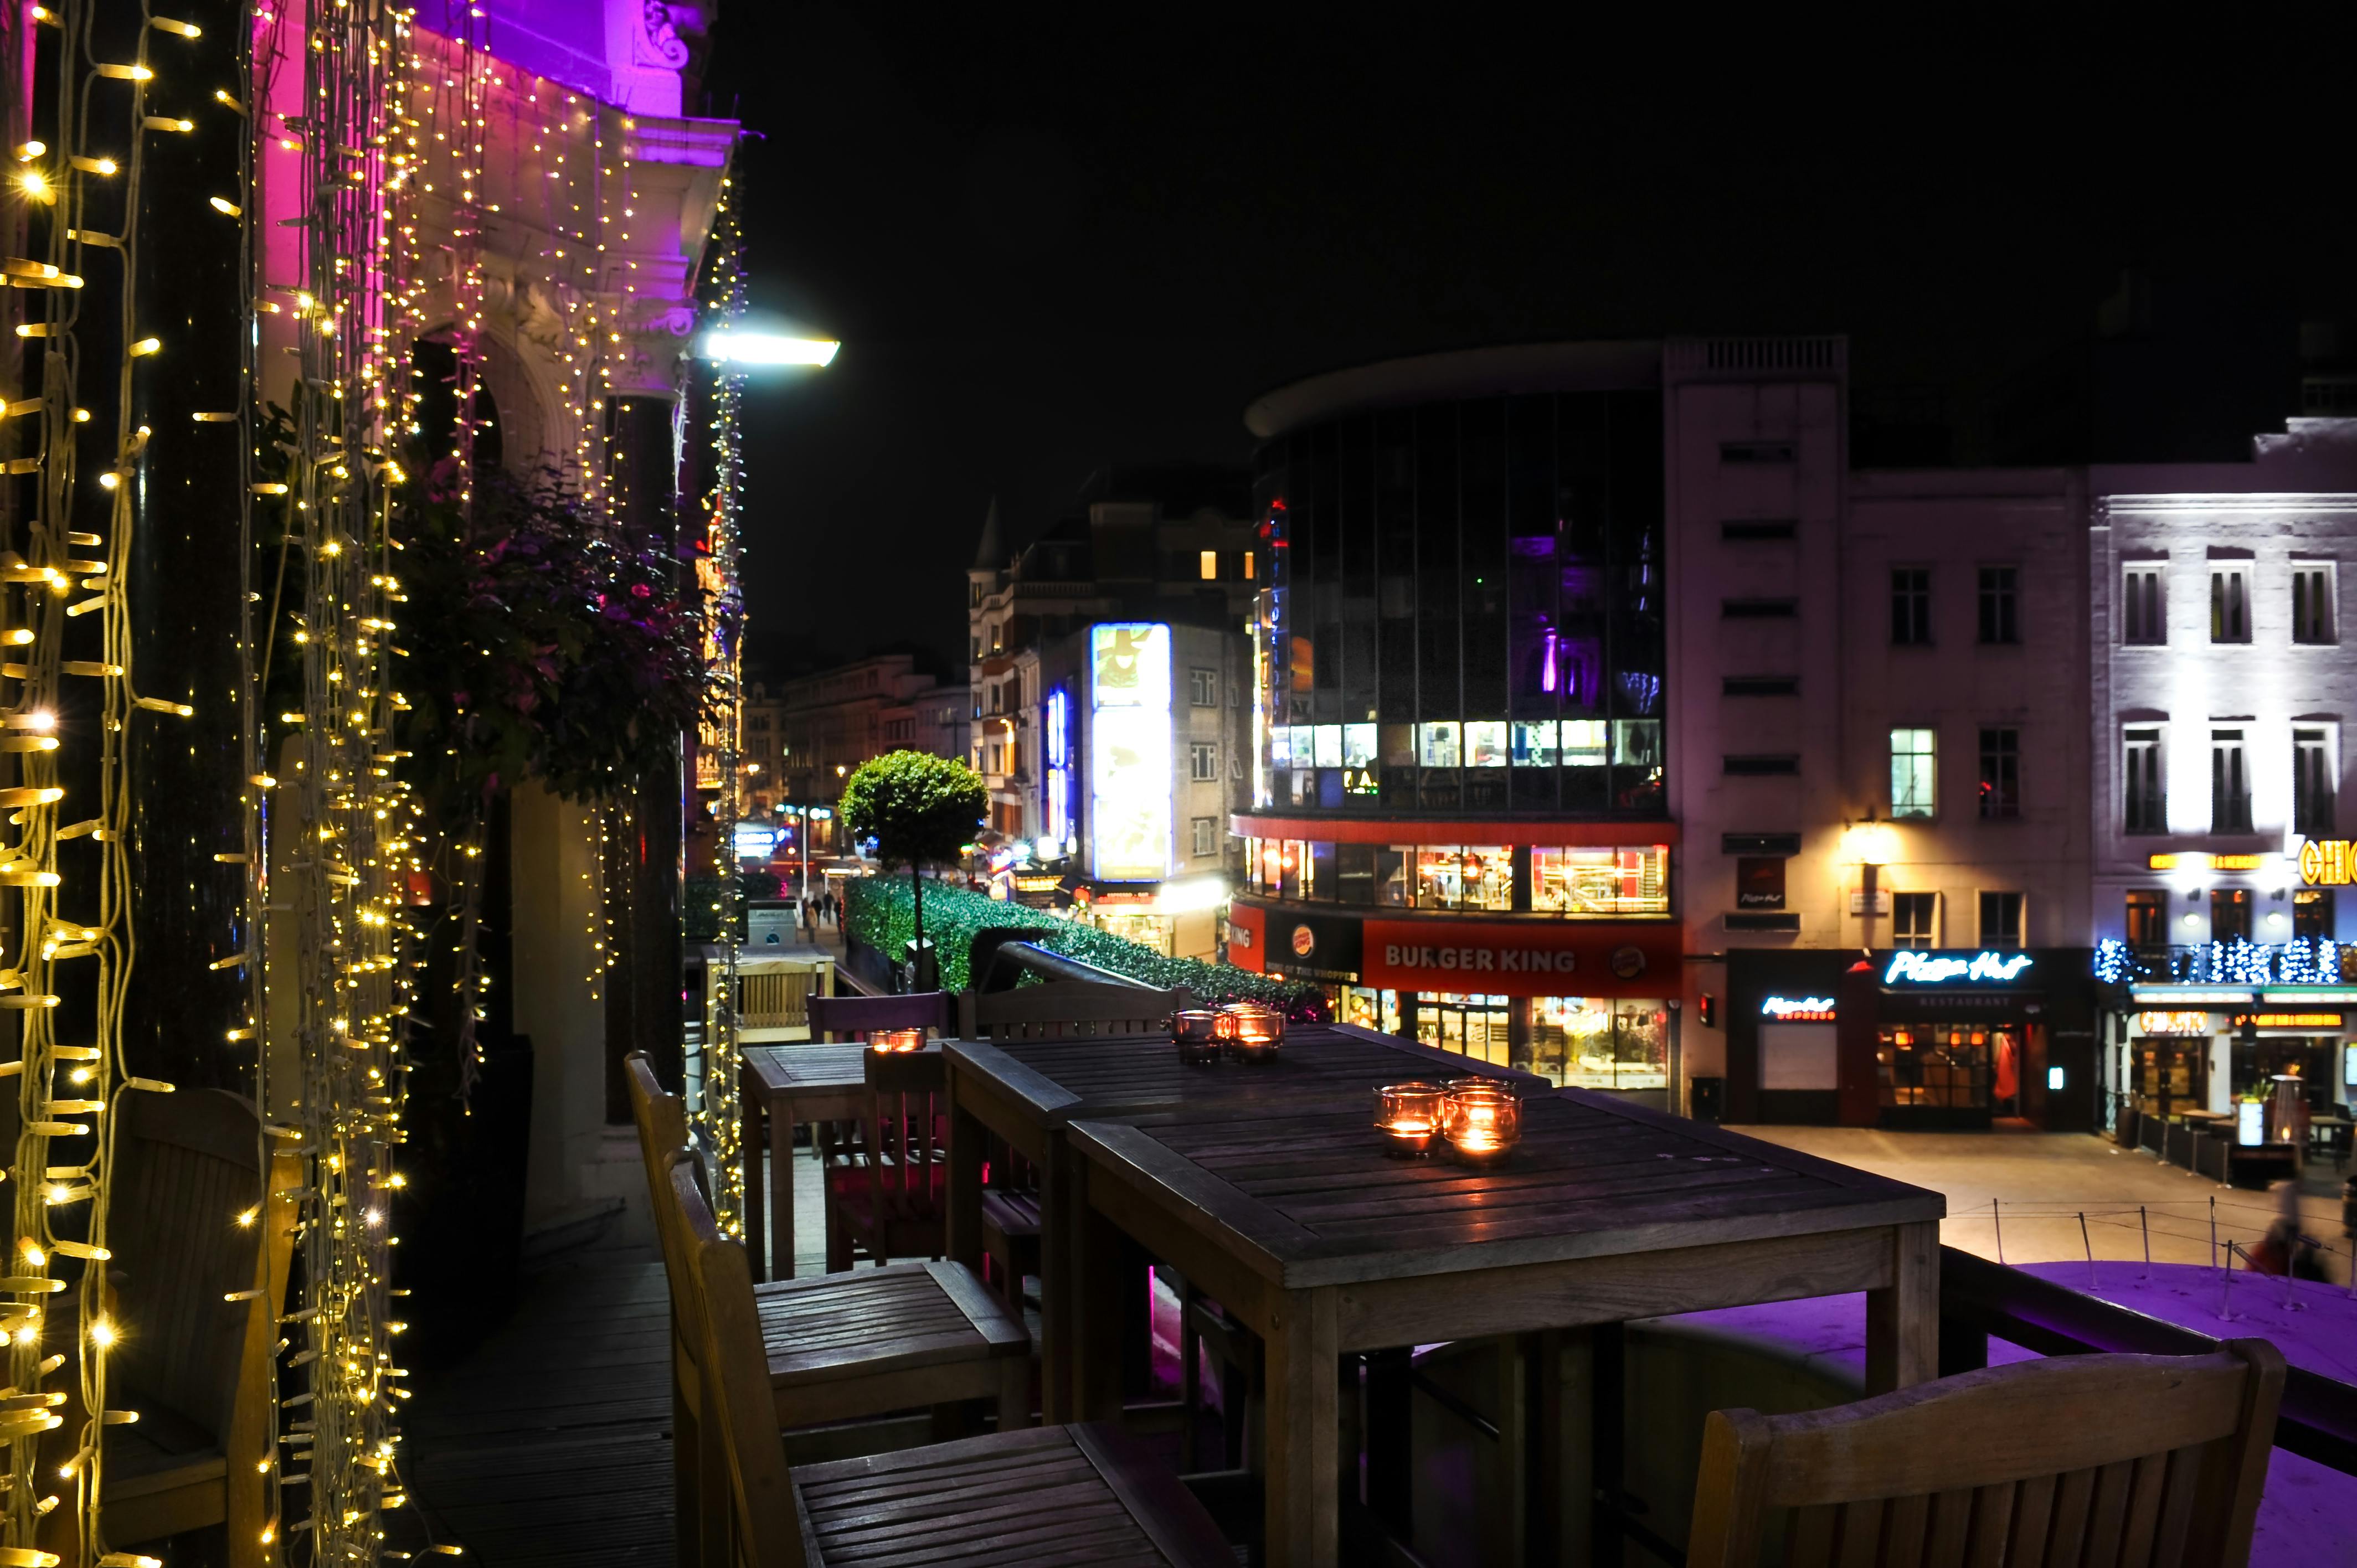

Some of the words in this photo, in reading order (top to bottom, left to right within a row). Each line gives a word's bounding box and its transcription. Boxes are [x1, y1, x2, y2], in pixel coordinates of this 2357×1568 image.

[1385, 945, 1494, 971] BURGER
[1500, 949, 1574, 973] KING
[1296, 966, 1312, 977] THE
[1314, 968, 1358, 982] WHOPPER
[1919, 997, 2010, 1006] RESTAURANT
